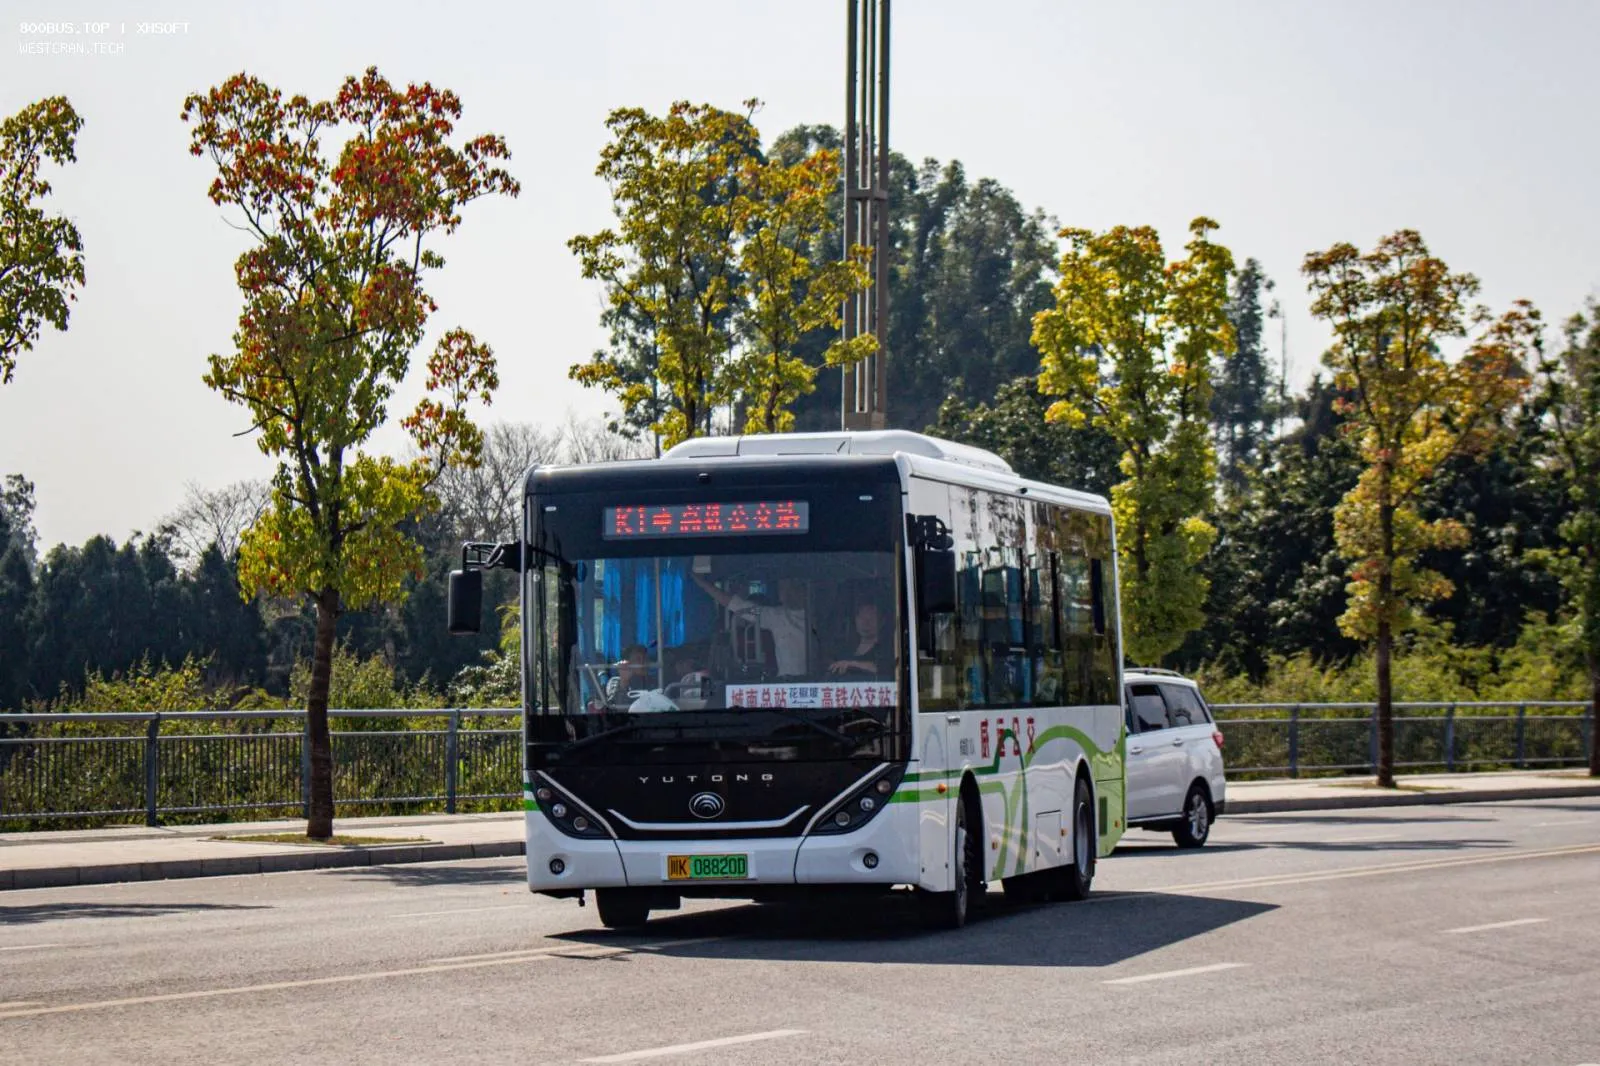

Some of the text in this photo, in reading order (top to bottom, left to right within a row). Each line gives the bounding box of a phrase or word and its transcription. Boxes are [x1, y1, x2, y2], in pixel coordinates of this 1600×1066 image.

[616, 506, 645, 533] K1
[731, 688, 787, 708] 城南总站
[821, 686, 892, 708] 高铁公交站
[639, 773, 773, 784] YUTONG
[670, 857, 746, 876] 川K 08820D
